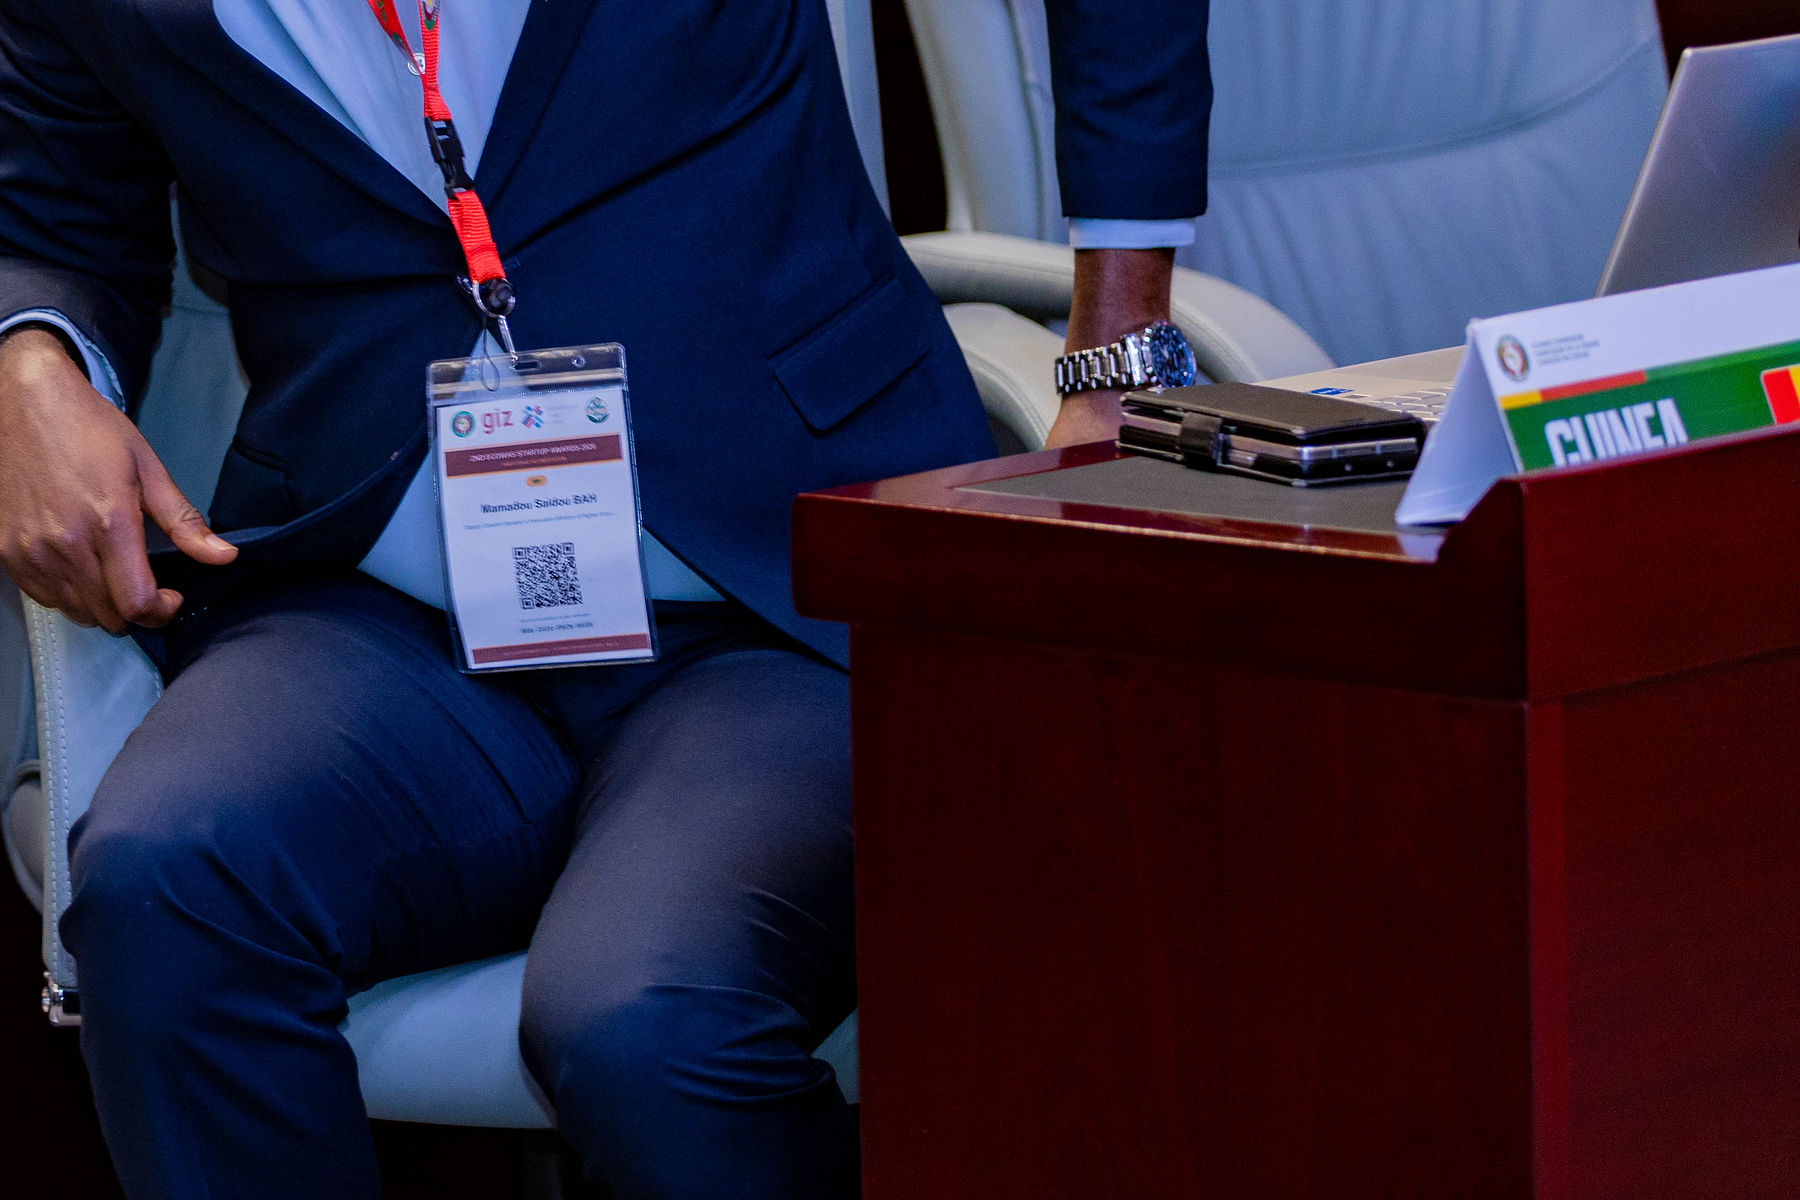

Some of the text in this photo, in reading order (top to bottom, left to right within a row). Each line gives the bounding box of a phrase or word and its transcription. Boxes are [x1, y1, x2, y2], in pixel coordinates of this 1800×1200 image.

[481, 408, 515, 435] giz
[1544, 398, 1689, 468] GUINEA
[481, 500, 533, 514] Mamadou
[534, 497, 571, 509] Saidou
